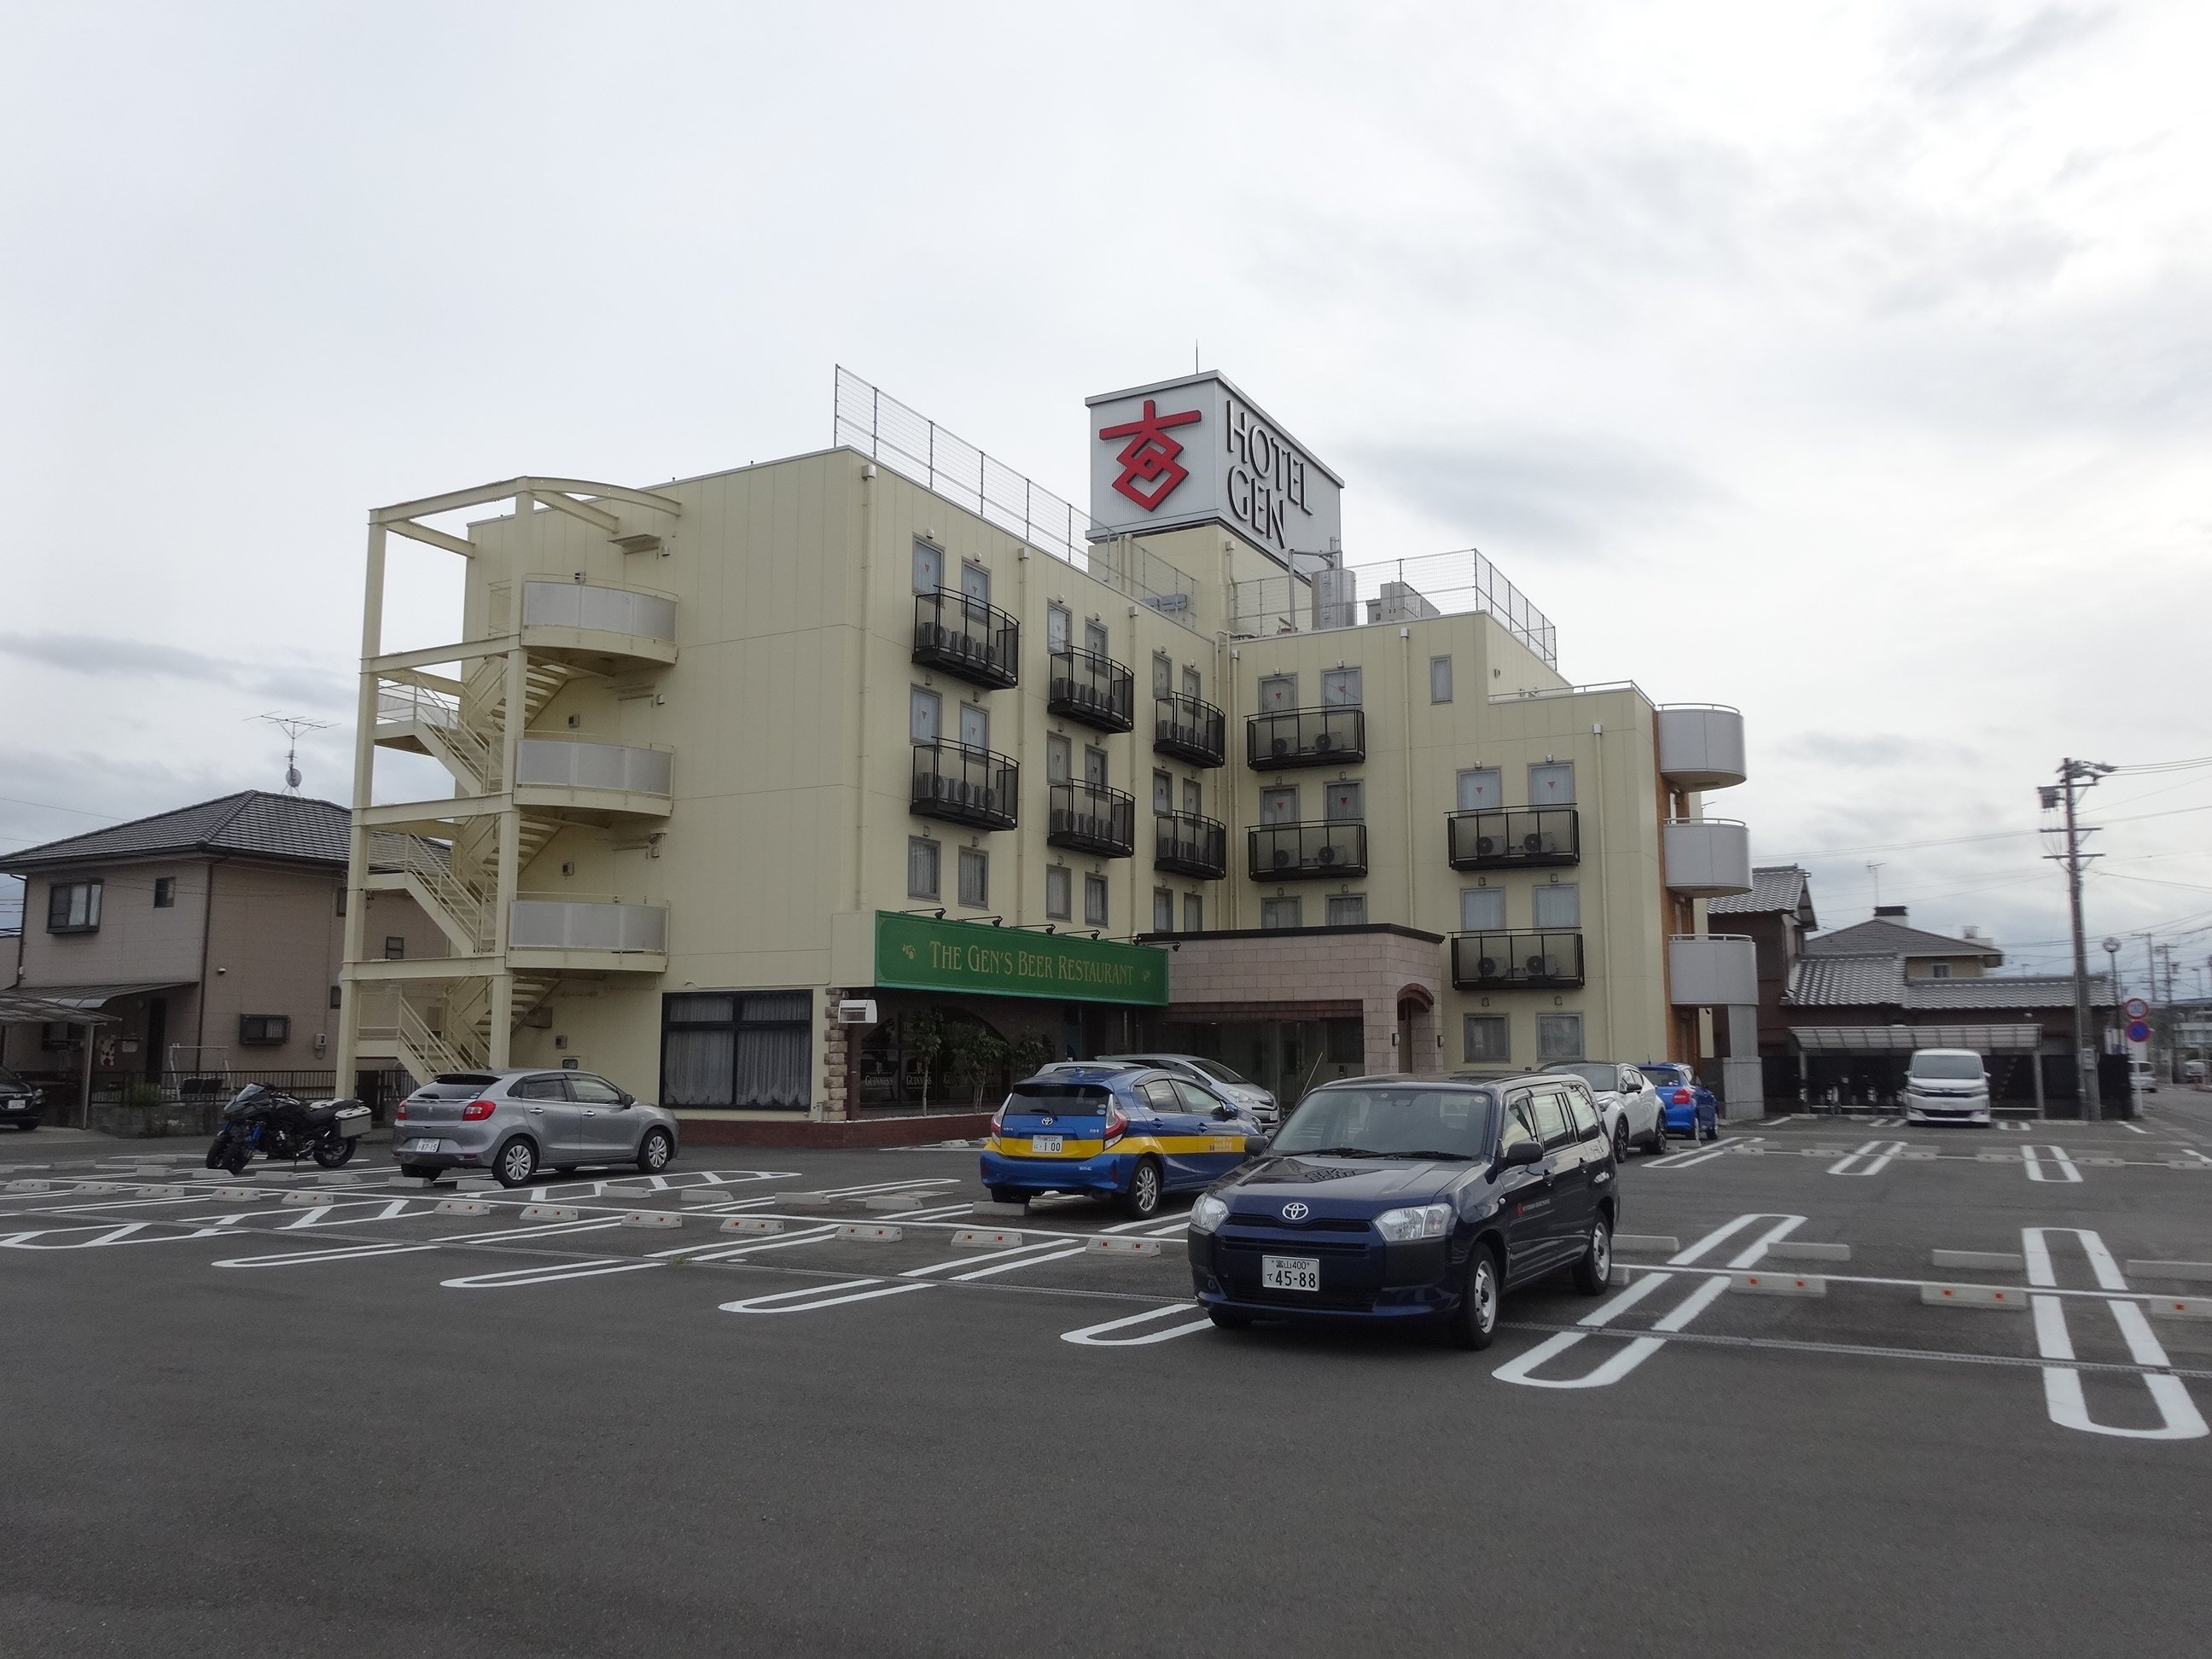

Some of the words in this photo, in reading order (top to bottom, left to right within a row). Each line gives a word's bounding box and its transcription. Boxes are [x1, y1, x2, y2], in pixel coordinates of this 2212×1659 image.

[1226, 400, 1313, 515] HOTEL
[1227, 465, 1285, 549] GEN
[929, 940, 962, 970] THE
[968, 945, 1013, 975] GEN'S
[1018, 951, 1053, 978] BEER
[1058, 955, 1133, 986] RESTAURANT
[864, 1074, 894, 1086] GUINNESS
[1275, 1270, 1316, 1288] 45-88
